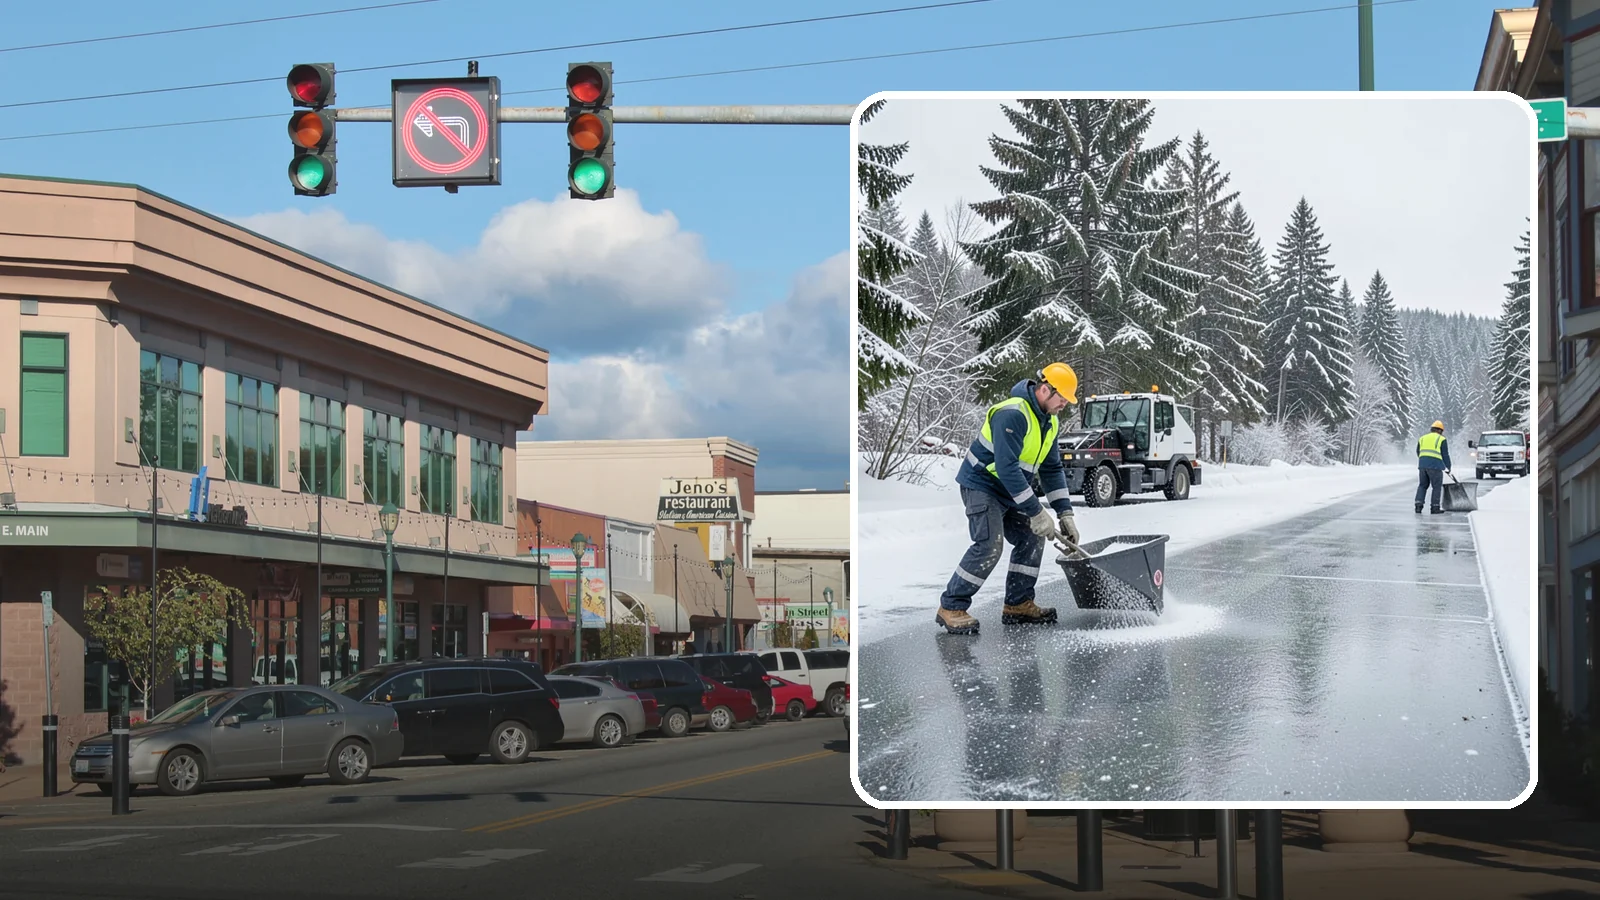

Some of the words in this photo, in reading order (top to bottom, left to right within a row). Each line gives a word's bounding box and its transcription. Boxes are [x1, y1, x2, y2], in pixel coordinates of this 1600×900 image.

[669, 480, 727, 494] Jeno's
[665, 496, 731, 509] restaurant
[658, 510, 681, 519] Italian
[686, 510, 714, 519] American
[715, 509, 738, 519] Cuisine
[2, 525, 13, 536] E.
[15, 525, 49, 536] MAIN
[797, 607, 828, 617] Street
[791, 619, 824, 627] lass
